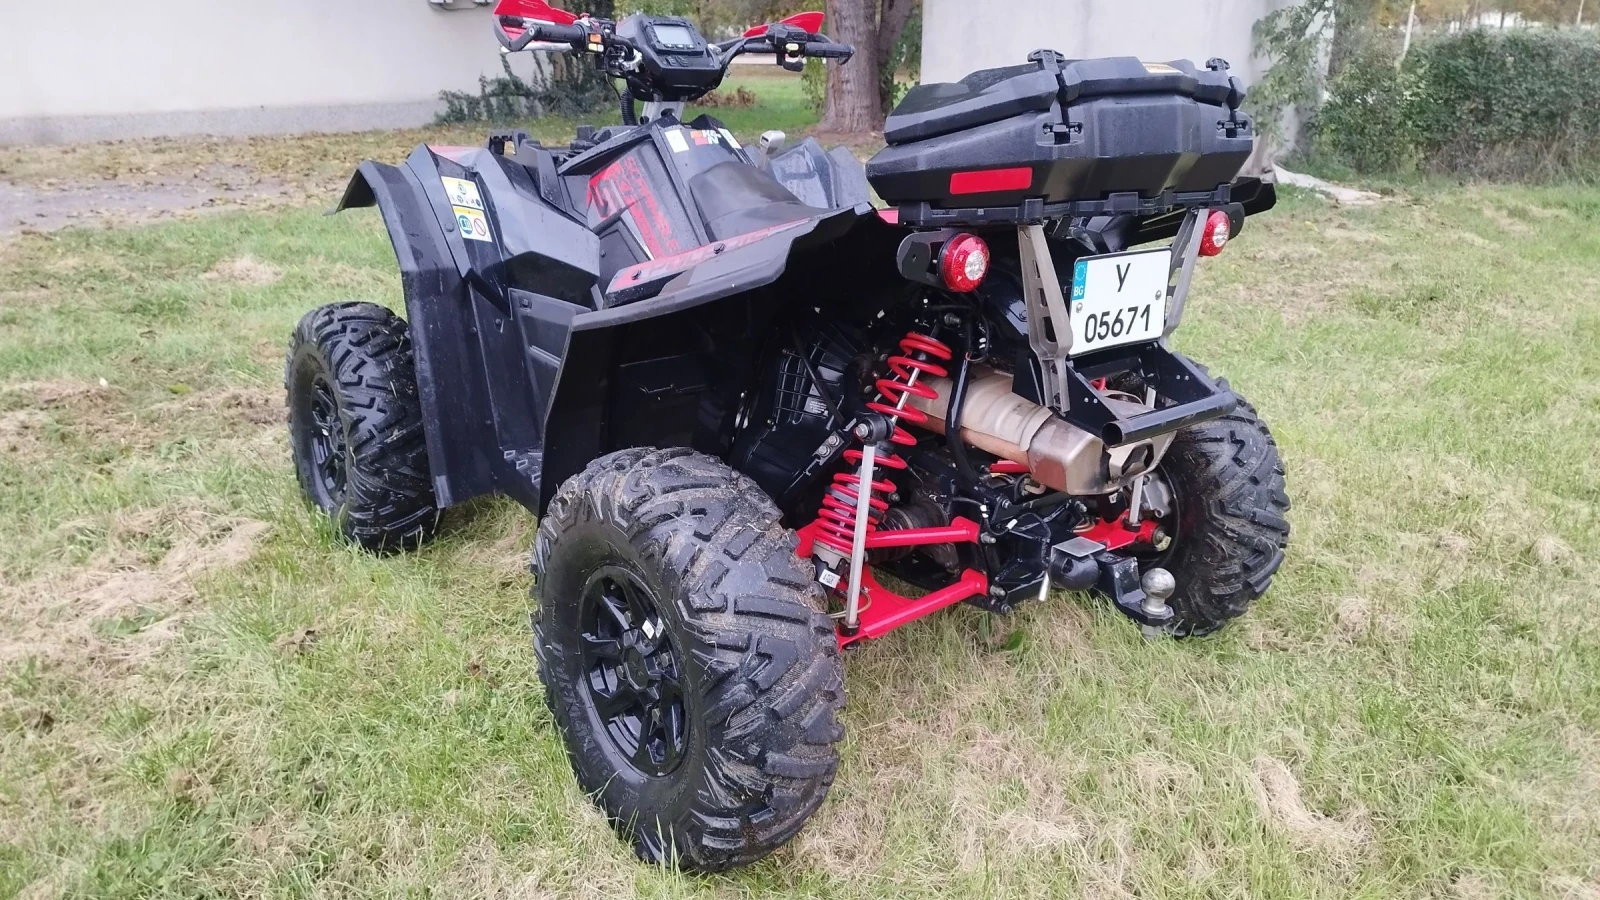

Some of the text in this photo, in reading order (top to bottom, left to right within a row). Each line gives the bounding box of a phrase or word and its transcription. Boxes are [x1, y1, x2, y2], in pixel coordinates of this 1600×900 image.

[1073, 285, 1084, 297] BG
[1116, 263, 1132, 292] Y
[1084, 303, 1151, 343] 05671
